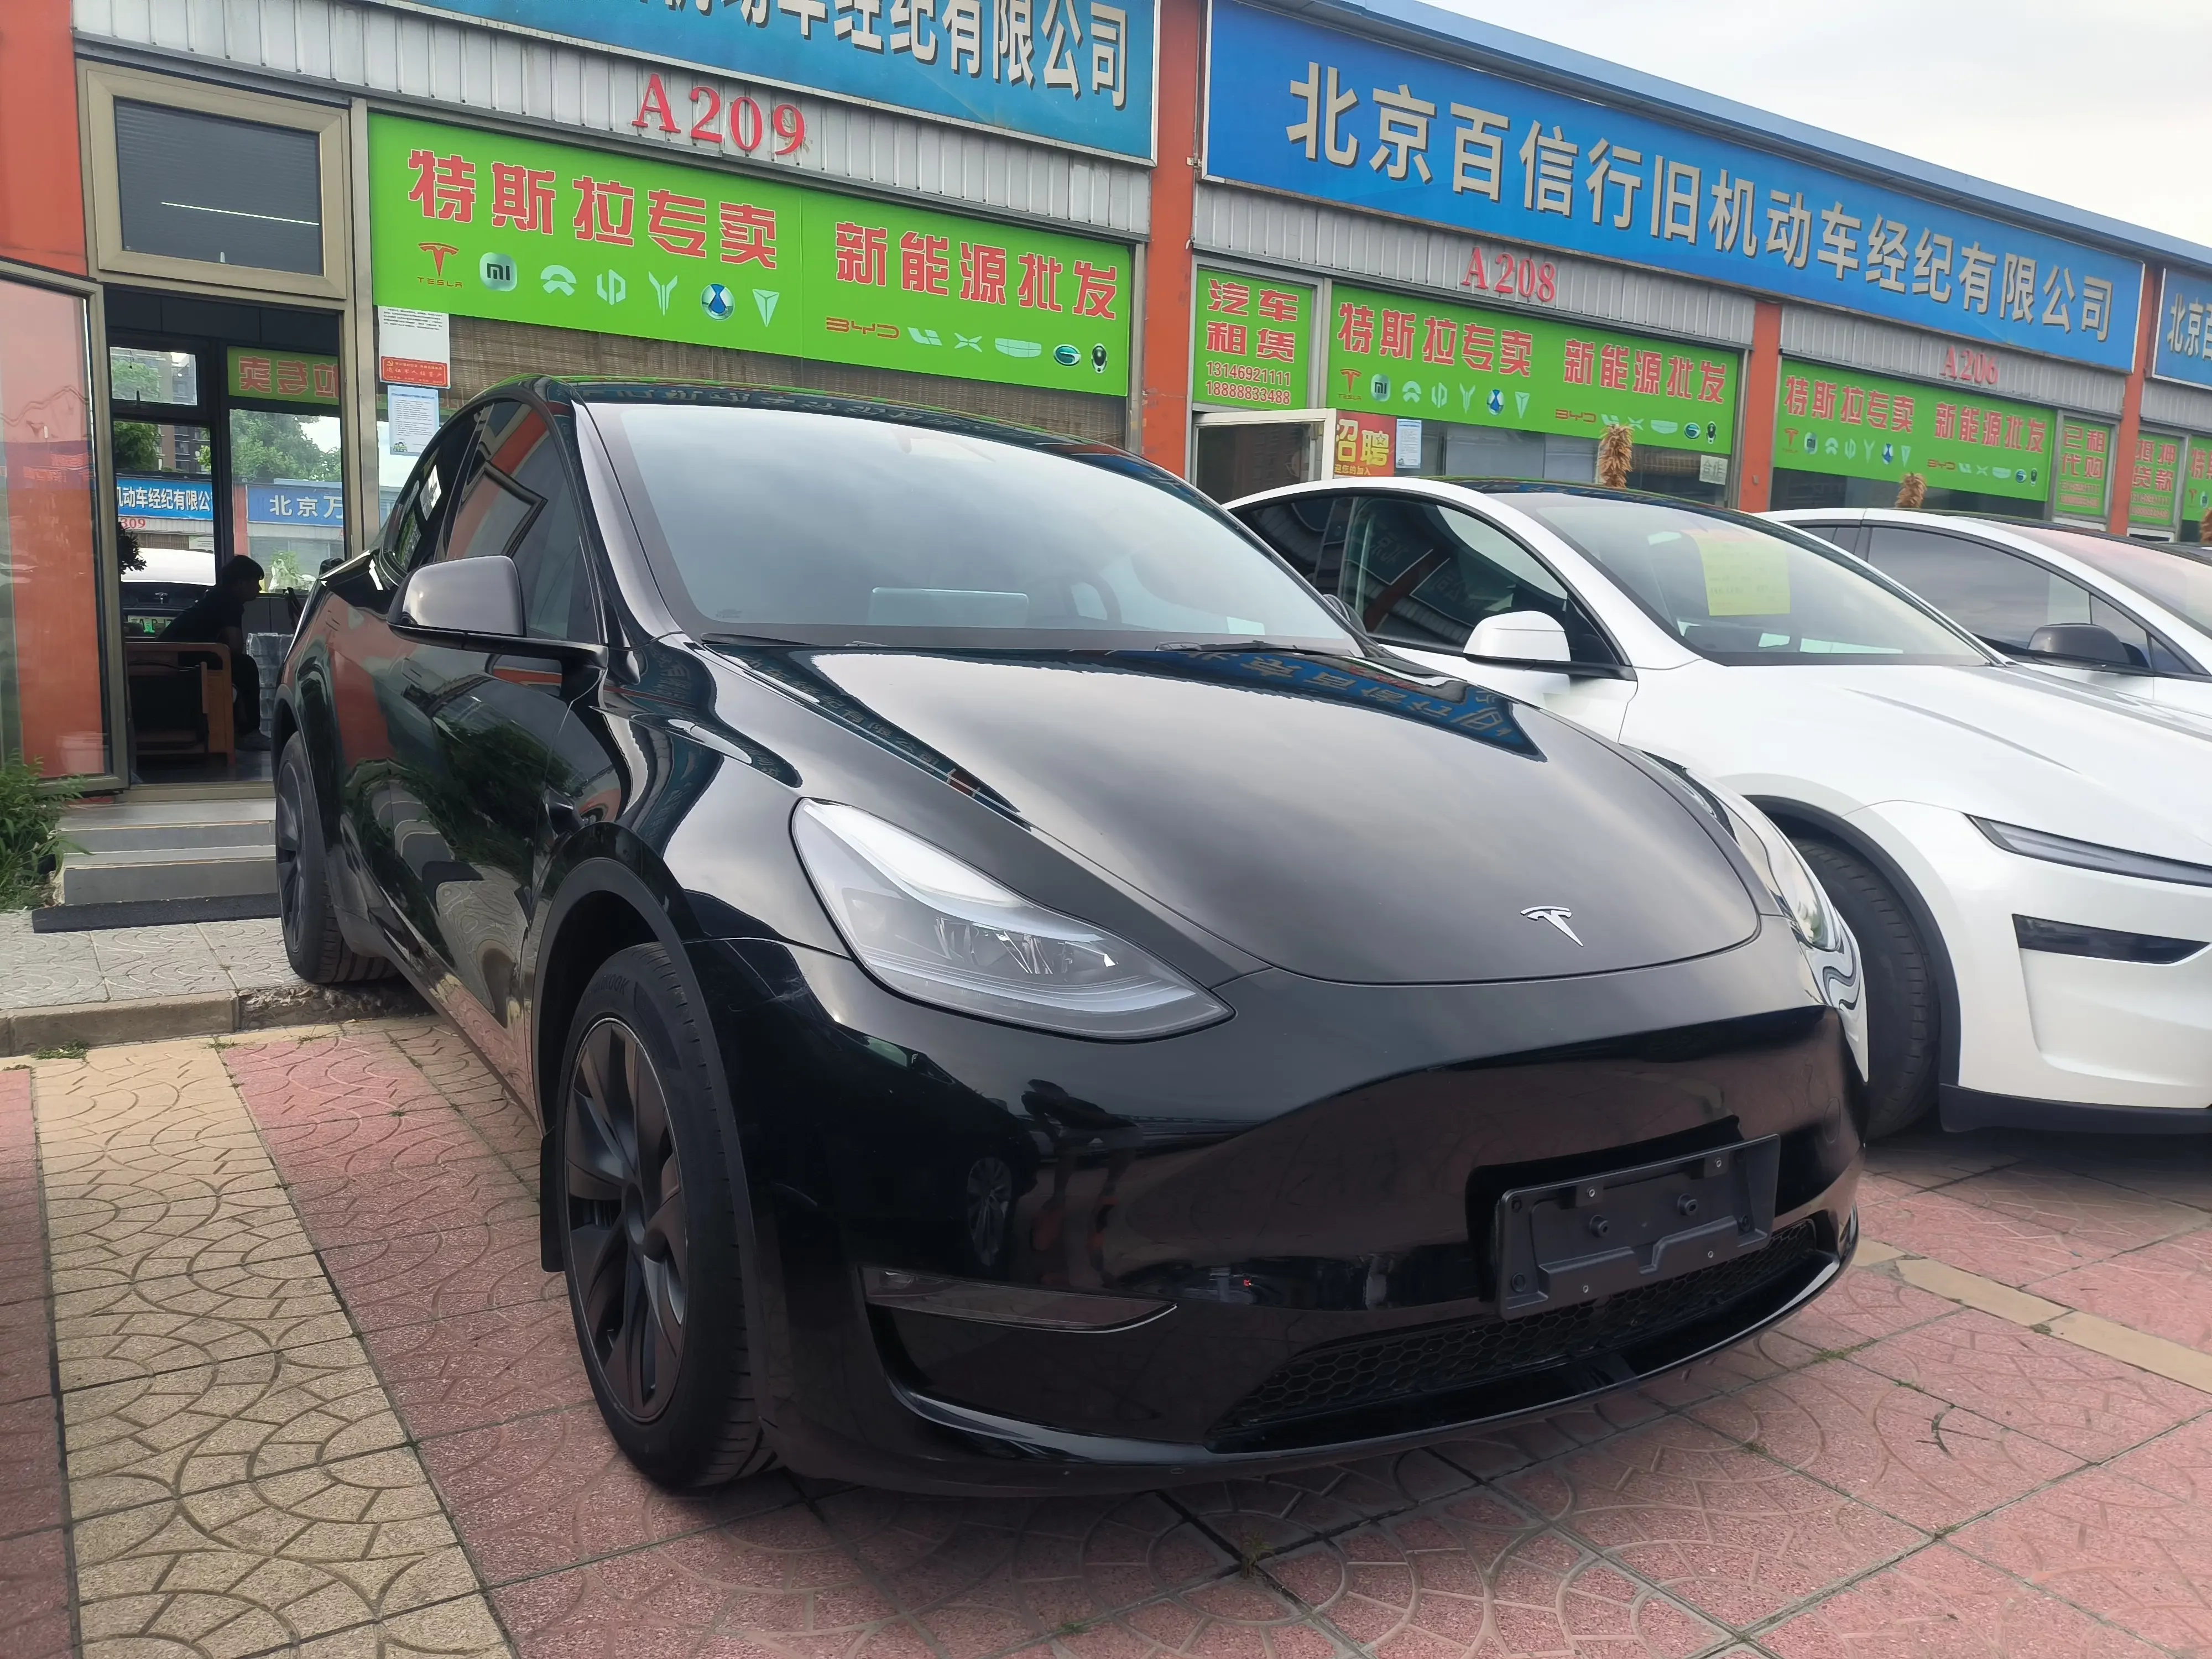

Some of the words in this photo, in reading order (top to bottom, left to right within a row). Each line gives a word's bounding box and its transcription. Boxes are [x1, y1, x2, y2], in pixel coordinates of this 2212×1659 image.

[632, 73, 806, 156] A209
[1286, 61, 2113, 341] 北京百信行旧机动车经纪有限公司
[408, 149, 777, 269] 特斯拉专卖
[836, 222, 1117, 320] 新能源批发
[416, 276, 462, 288] TESLA
[1460, 247, 1556, 302] A208
[1207, 278, 1298, 322] 汽车
[826, 317, 900, 339] BYD
[1206, 321, 1295, 363] 租赁
[1206, 361, 1291, 386] 13146921111
[1338, 302, 1533, 378] 特斯拉专卖
[1563, 338, 1726, 404] 新能源批发
[1939, 345, 1999, 384] A206
[1206, 380, 1291, 405] 18888833488
[1784, 374, 1914, 434] 特斯拉专卖
[1934, 401, 2047, 453] 新能源批发
[1336, 419, 1389, 466] 招聘
[2190, 447, 2212, 480] 特
[117, 486, 212, 512] 动车经纪有限公
